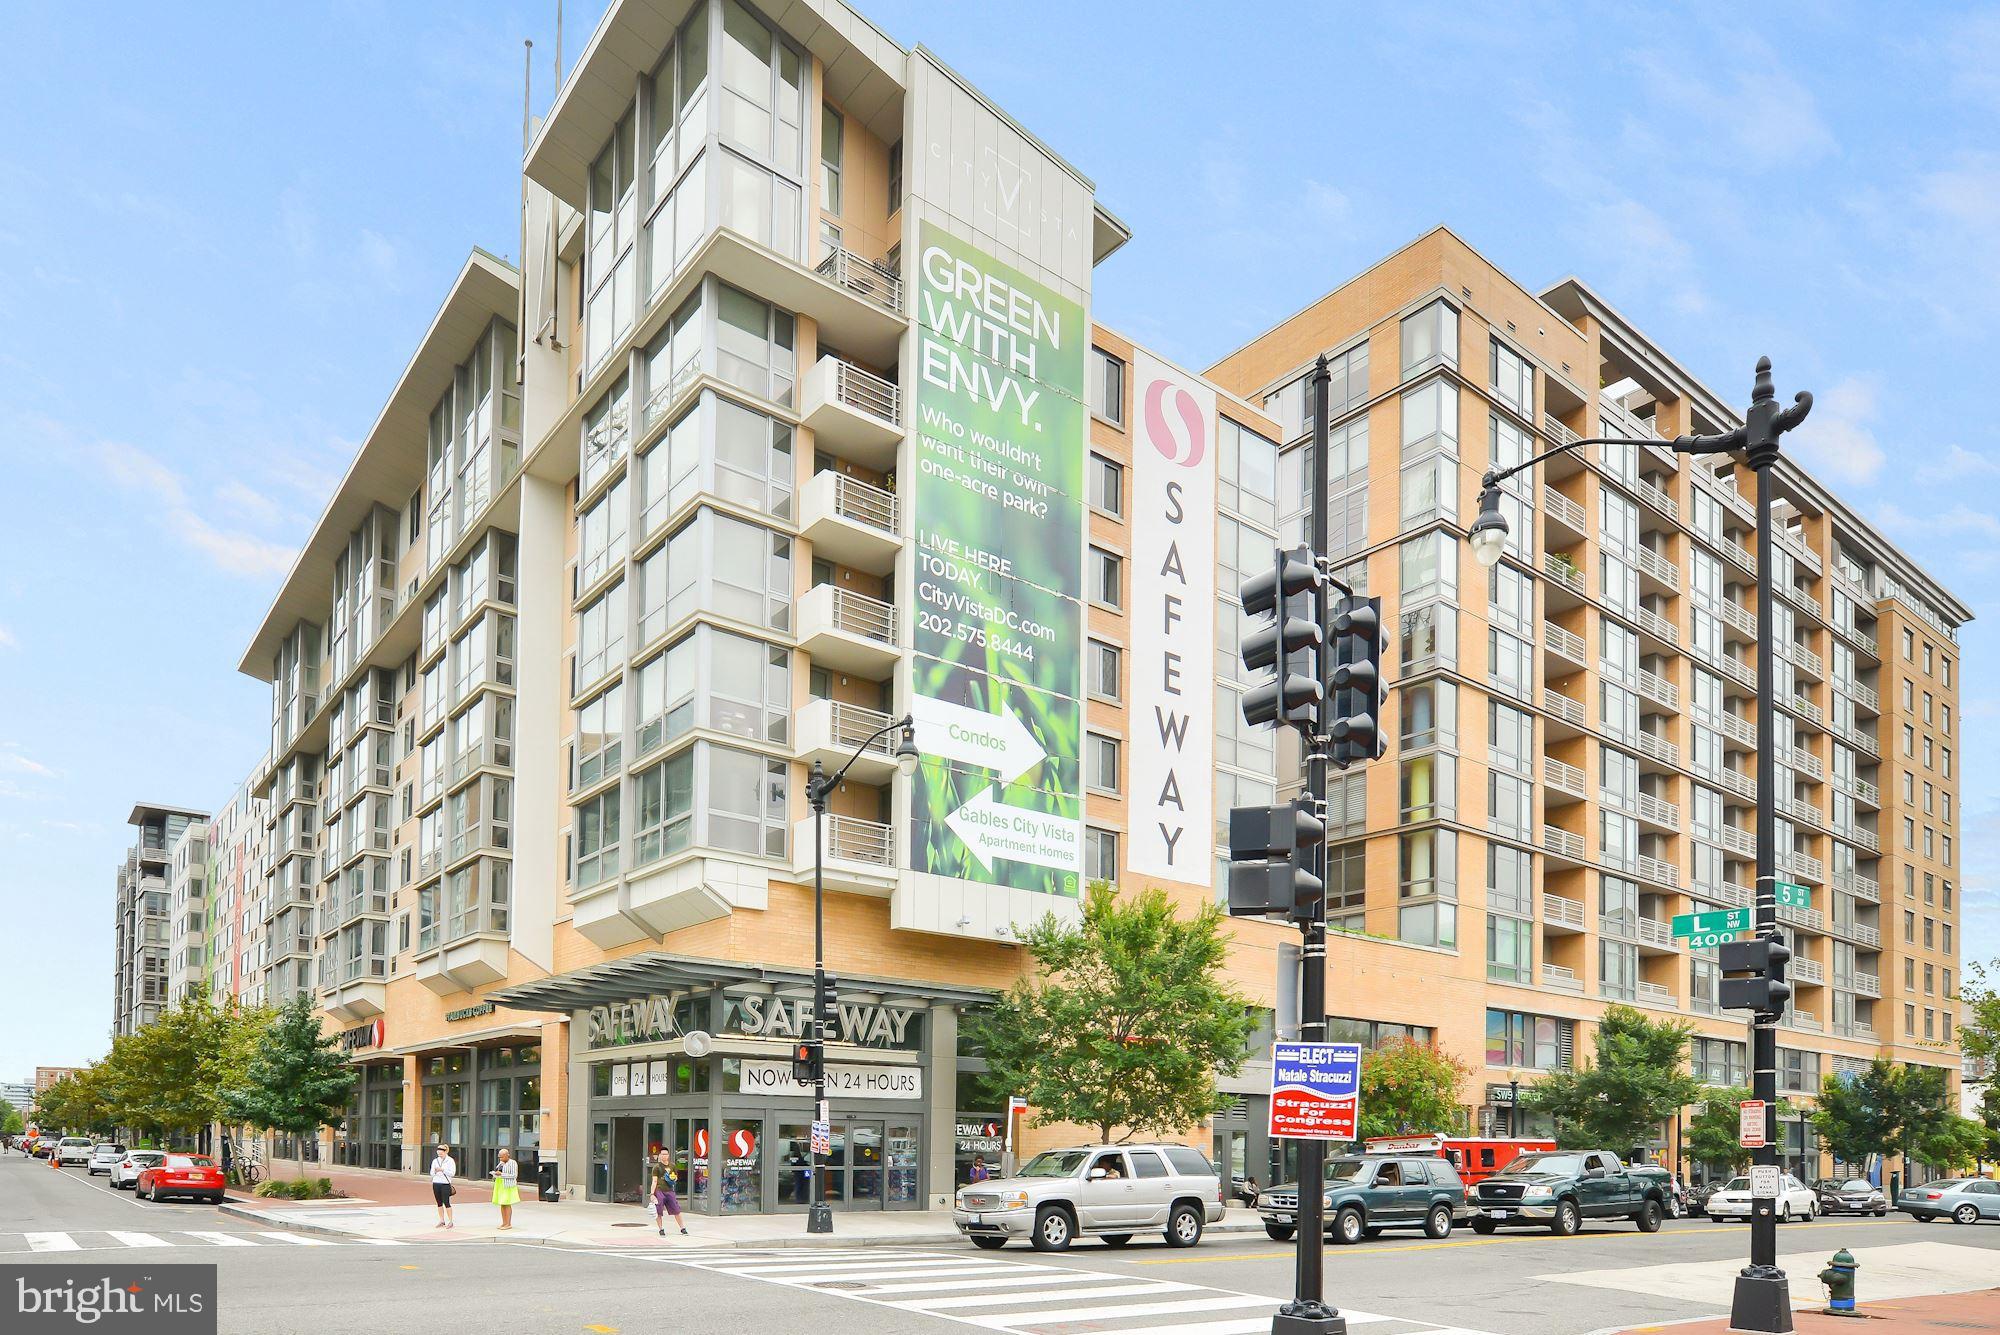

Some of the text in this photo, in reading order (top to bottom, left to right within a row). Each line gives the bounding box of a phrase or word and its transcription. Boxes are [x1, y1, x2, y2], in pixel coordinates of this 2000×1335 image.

[922, 246, 1060, 350] GREEN
[923, 290, 1036, 383] WITH
[923, 338, 1042, 432] ENVY.
[921, 403, 1042, 471] Who wouldn't
[921, 434, 1047, 497] want their own
[920, 458, 1048, 519] one-acre park?
[920, 529, 1011, 574] LIVE HERE
[919, 552, 983, 591] TODAY.
[919, 581, 1055, 642] CityVistaDC.com
[919, 611, 1034, 662] 202.575.8444
[1155, 481, 1190, 866] SAFEWAY
[948, 724, 1006, 752] Condos
[959, 806, 1075, 842] Gables City Vista
[979, 832, 1074, 861] Apartment Homes
[1782, 886, 1805, 903] 5 ST
[1693, 912, 1740, 932] L ST
[1690, 933, 1734, 947] 400
[588, 991, 679, 1042] SAFEWAY
[1299, 1047, 1334, 1065] ELECT
[634, 1072, 645, 1087] 24
[748, 1068, 792, 1086] NOW
[843, 1072, 861, 1089] 24
[866, 1073, 915, 1091] HOURS
[1278, 1068, 1352, 1084] Natale Stracuzzi
[1275, 1098, 1353, 1110] Stracuzzi
[1299, 1107, 1327, 1117] For
[955, 1124, 984, 1136] EWAY
[1274, 1114, 1352, 1126] Congress
[960, 1140, 1001, 1150] 24 HOURS
[726, 1158, 756, 1167] SAFEWAY
